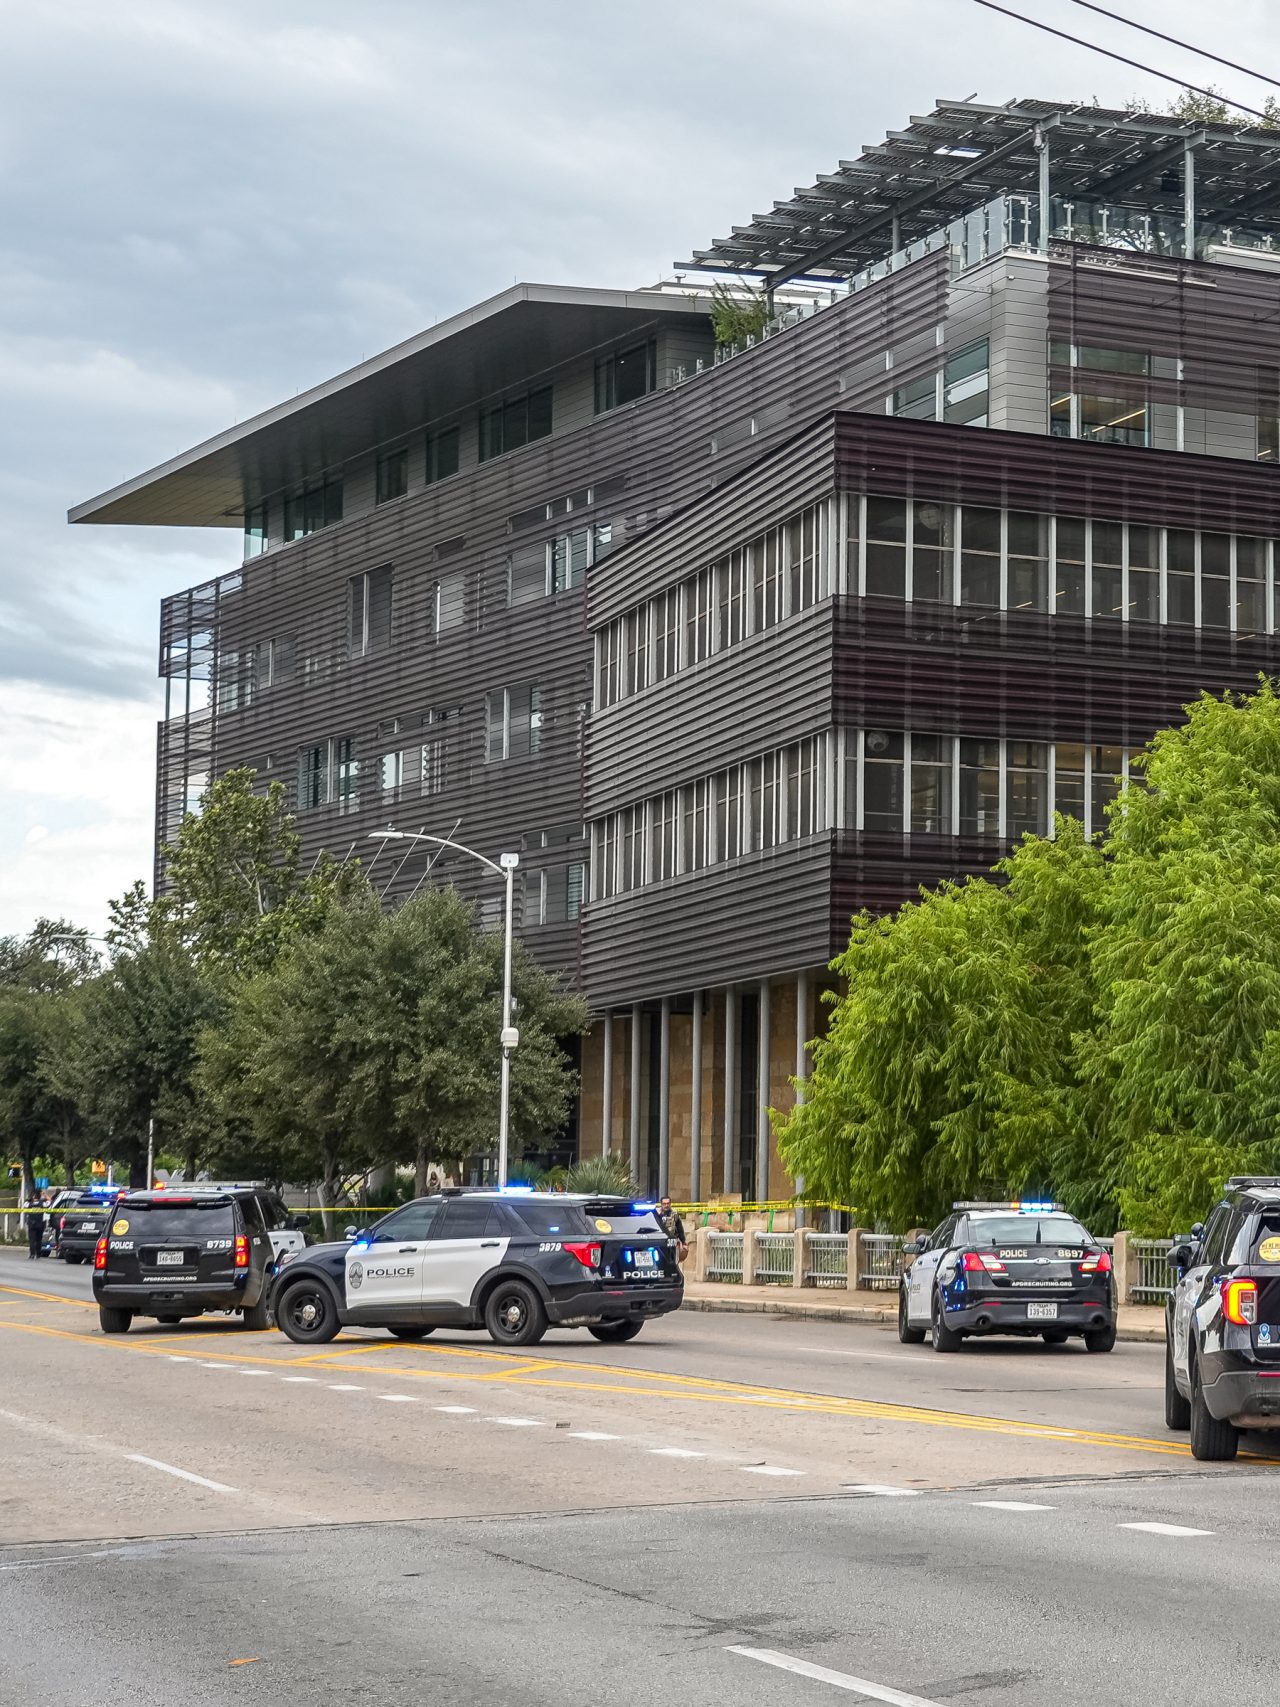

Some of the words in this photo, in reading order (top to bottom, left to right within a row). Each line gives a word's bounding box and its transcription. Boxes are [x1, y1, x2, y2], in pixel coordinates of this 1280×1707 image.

[110, 1241, 134, 1250] POLICE
[1000, 1250, 1028, 1258] POLICE
[1057, 1250, 1083, 1258] 8697
[366, 1267, 415, 1277] POLICE
[623, 1270, 665, 1279] POLICE
